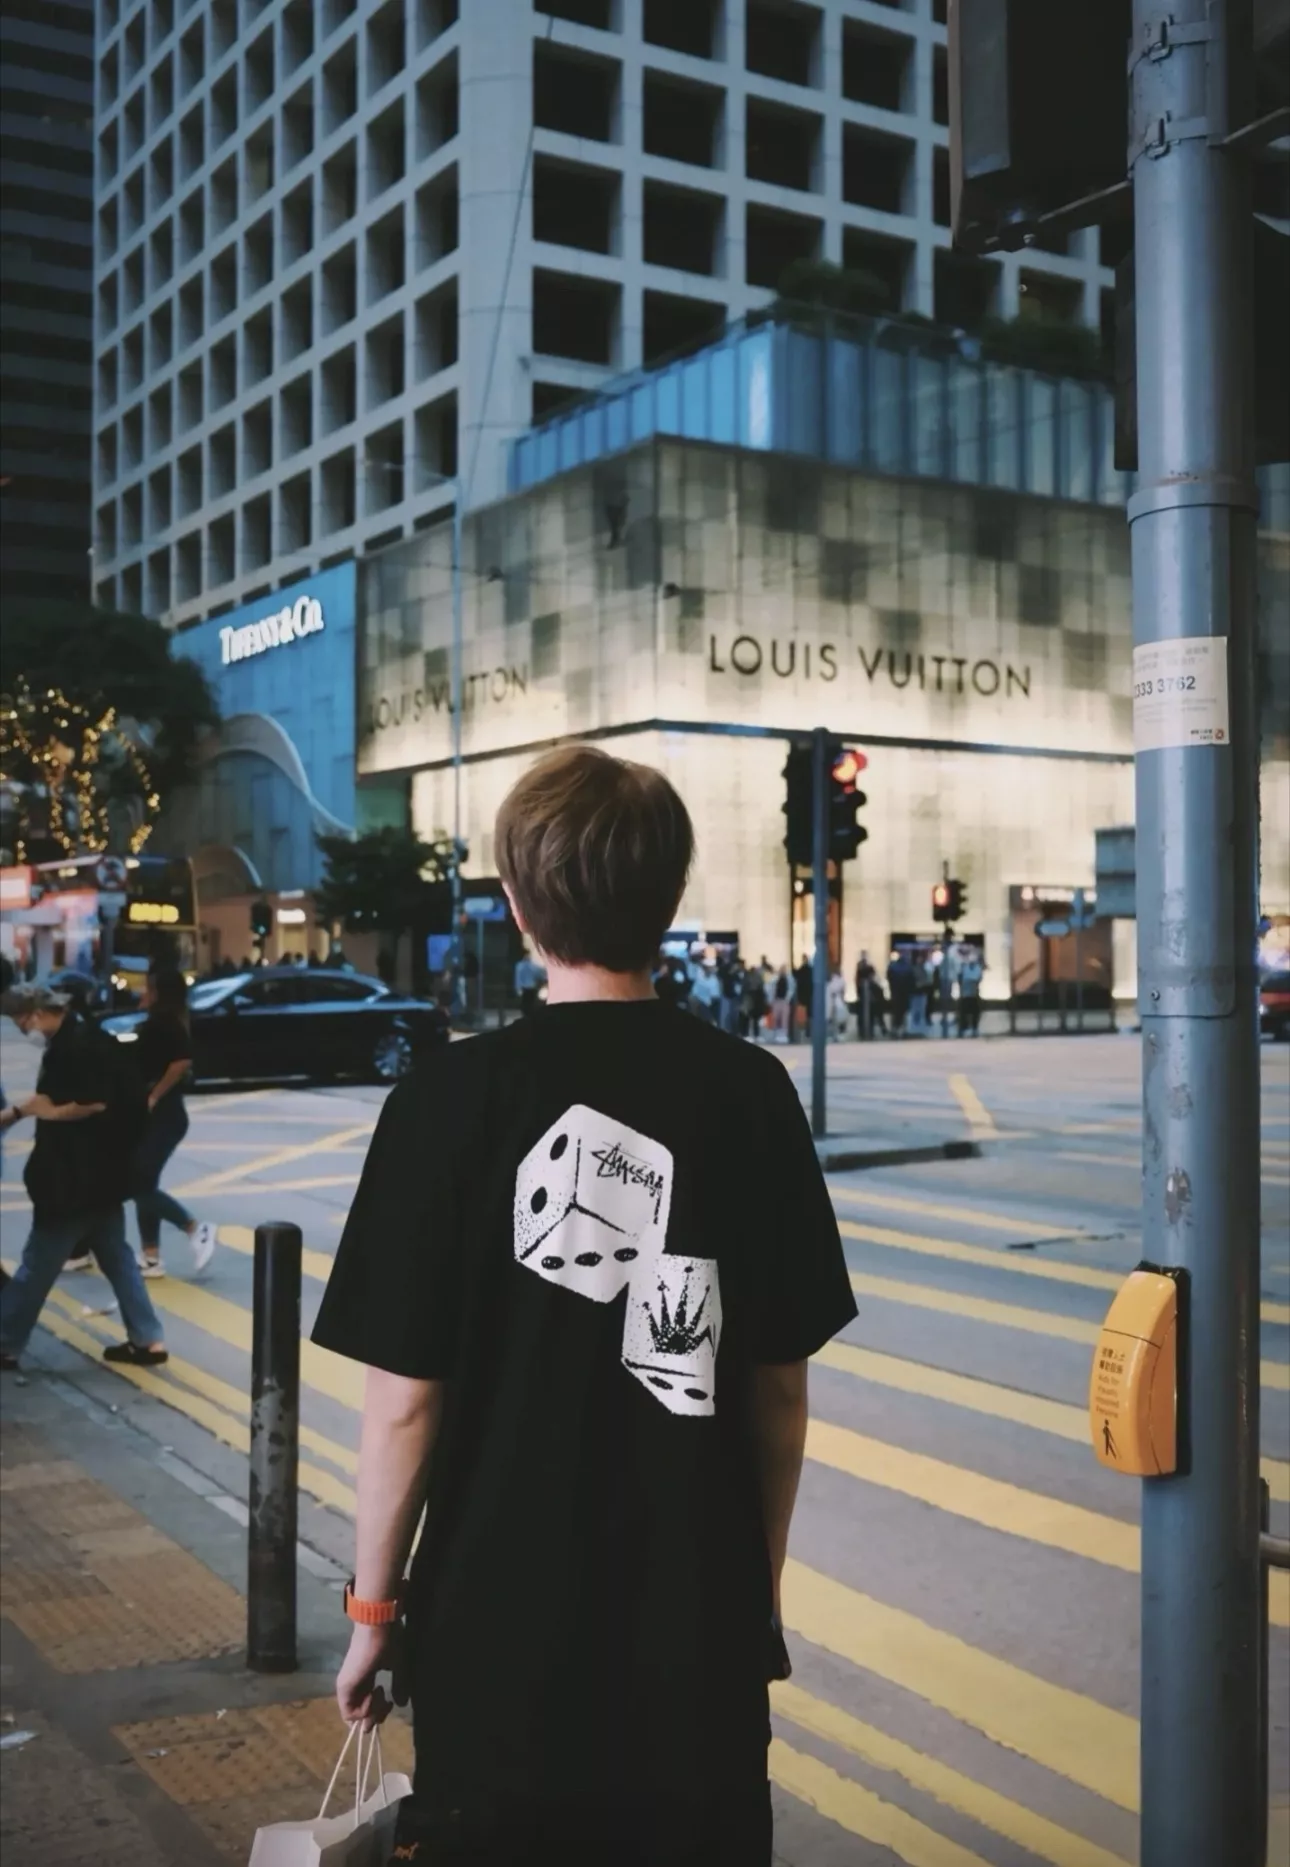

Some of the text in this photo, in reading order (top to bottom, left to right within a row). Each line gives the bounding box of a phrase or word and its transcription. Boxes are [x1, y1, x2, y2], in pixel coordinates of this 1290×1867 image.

[709, 634, 1031, 698] LOUIS VUITTON
[1133, 675, 1197, 699] 333 3762
